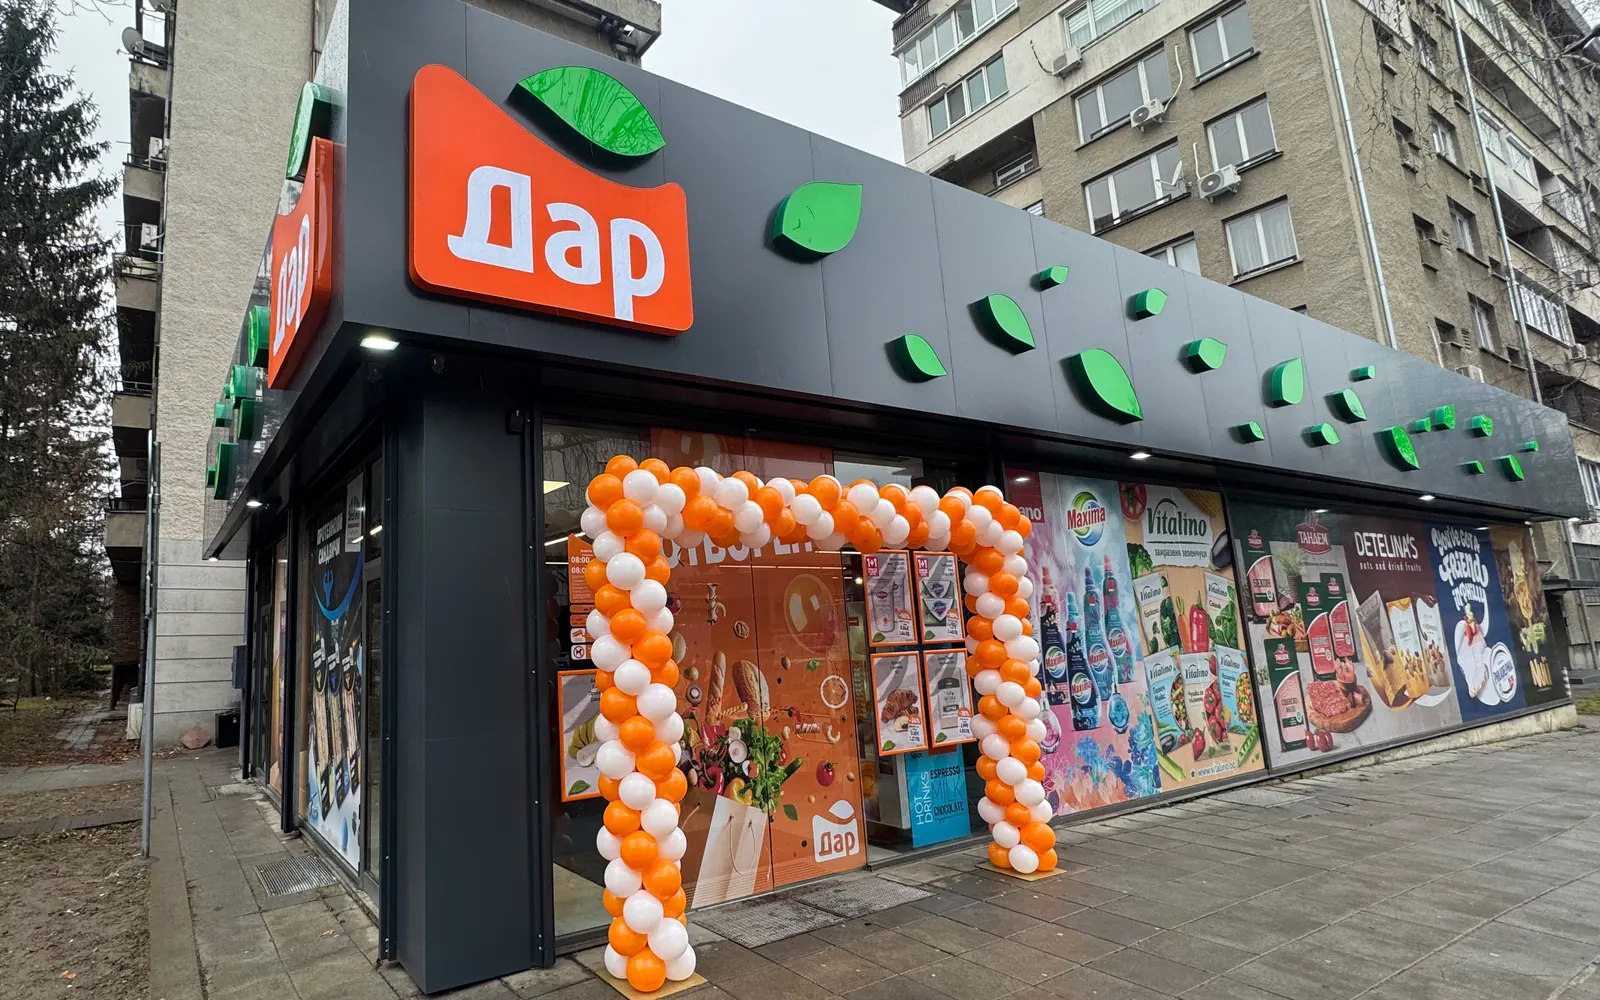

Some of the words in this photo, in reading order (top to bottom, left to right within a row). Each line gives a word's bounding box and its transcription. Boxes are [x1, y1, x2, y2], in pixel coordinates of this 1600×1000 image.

[447, 165, 665, 321] Дар
[273, 213, 310, 357] Дар
[1019, 505, 1042, 520] ano
[1067, 507, 1106, 530] Maxima
[1147, 497, 1207, 537] Vitalino
[1298, 531, 1329, 546] ТАНДЕМ
[1354, 531, 1418, 559] DETELINA'S
[1360, 562, 1373, 570] nuts
[1375, 561, 1386, 570] and
[1388, 561, 1403, 571] dried
[1405, 562, 1422, 572] fruits
[930, 765, 961, 780] ESPRESSO
[914, 795, 925, 825] HOT
[921, 771, 934, 824] DRINKS
[934, 801, 965, 817] CHOCOLATE
[818, 831, 856, 857] Дар
